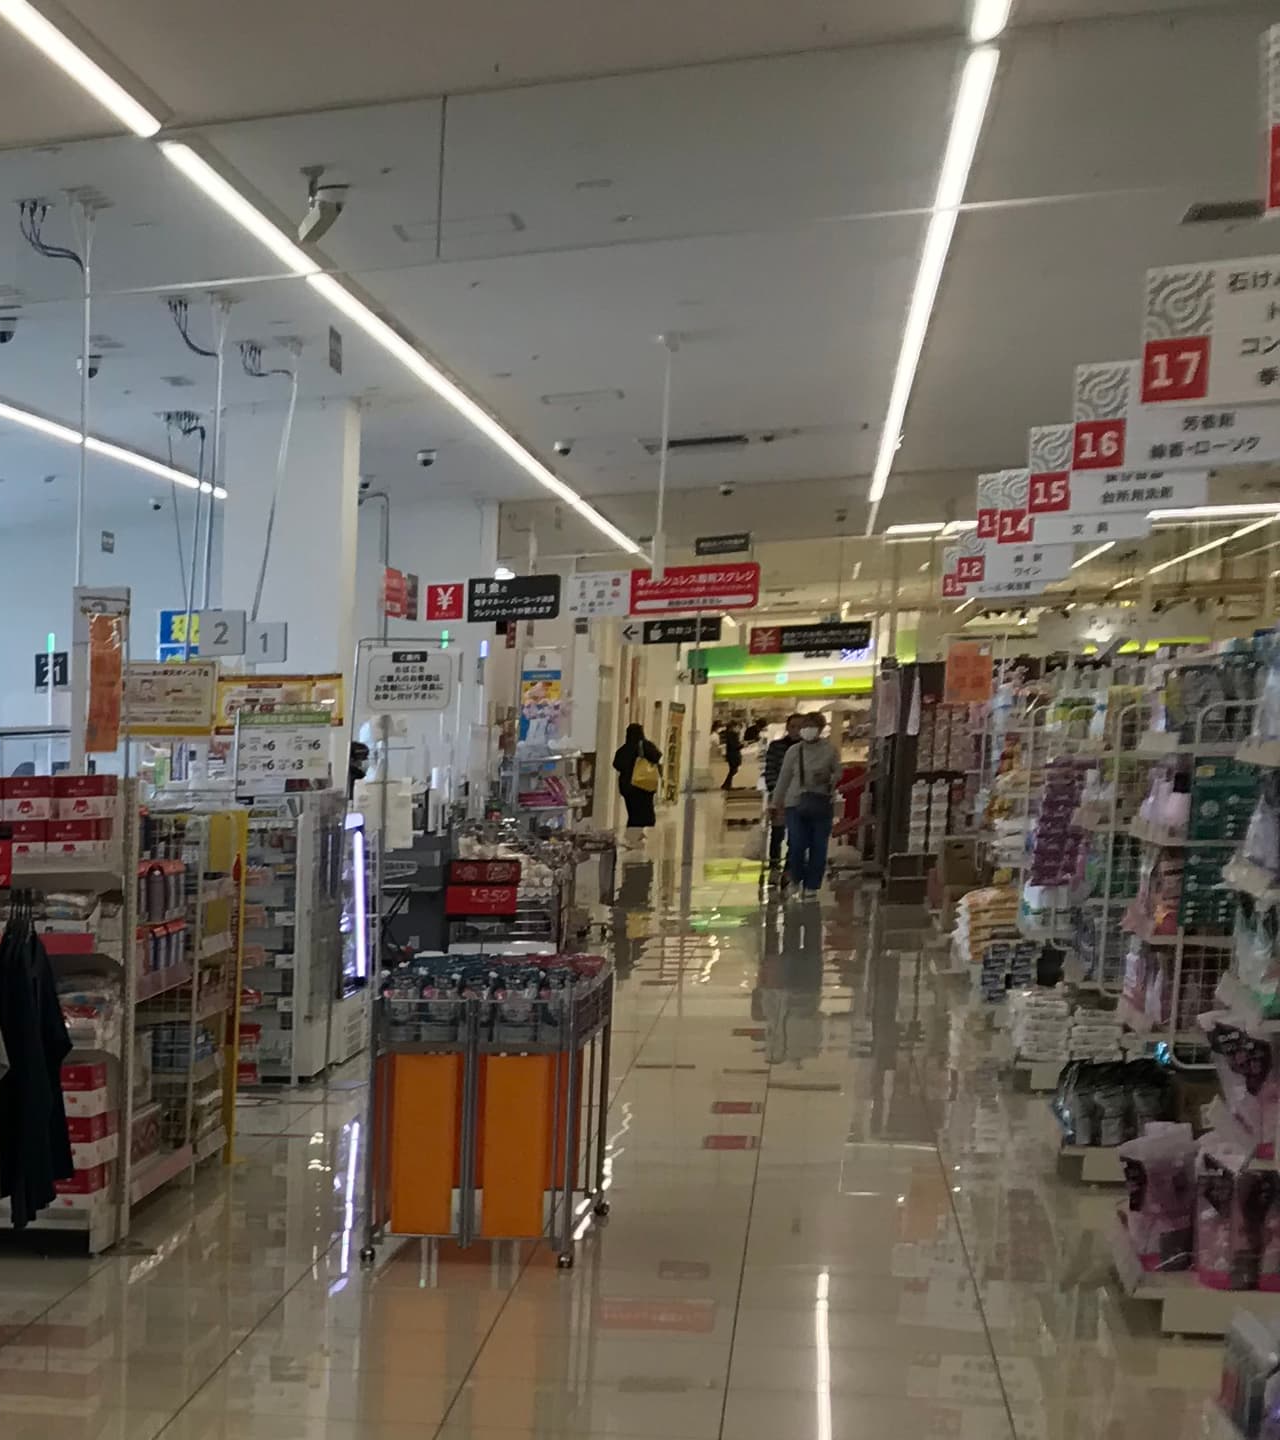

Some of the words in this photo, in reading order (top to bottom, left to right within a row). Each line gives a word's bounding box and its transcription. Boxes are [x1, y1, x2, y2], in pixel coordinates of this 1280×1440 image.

[1148, 351, 1201, 389] 17
[1078, 430, 1119, 459] 16
[1033, 480, 1066, 505] 15
[1000, 513, 1030, 536] 14
[961, 562, 981, 577] 12
[214, 622, 229, 645] 2
[259, 632, 268, 653] 1
